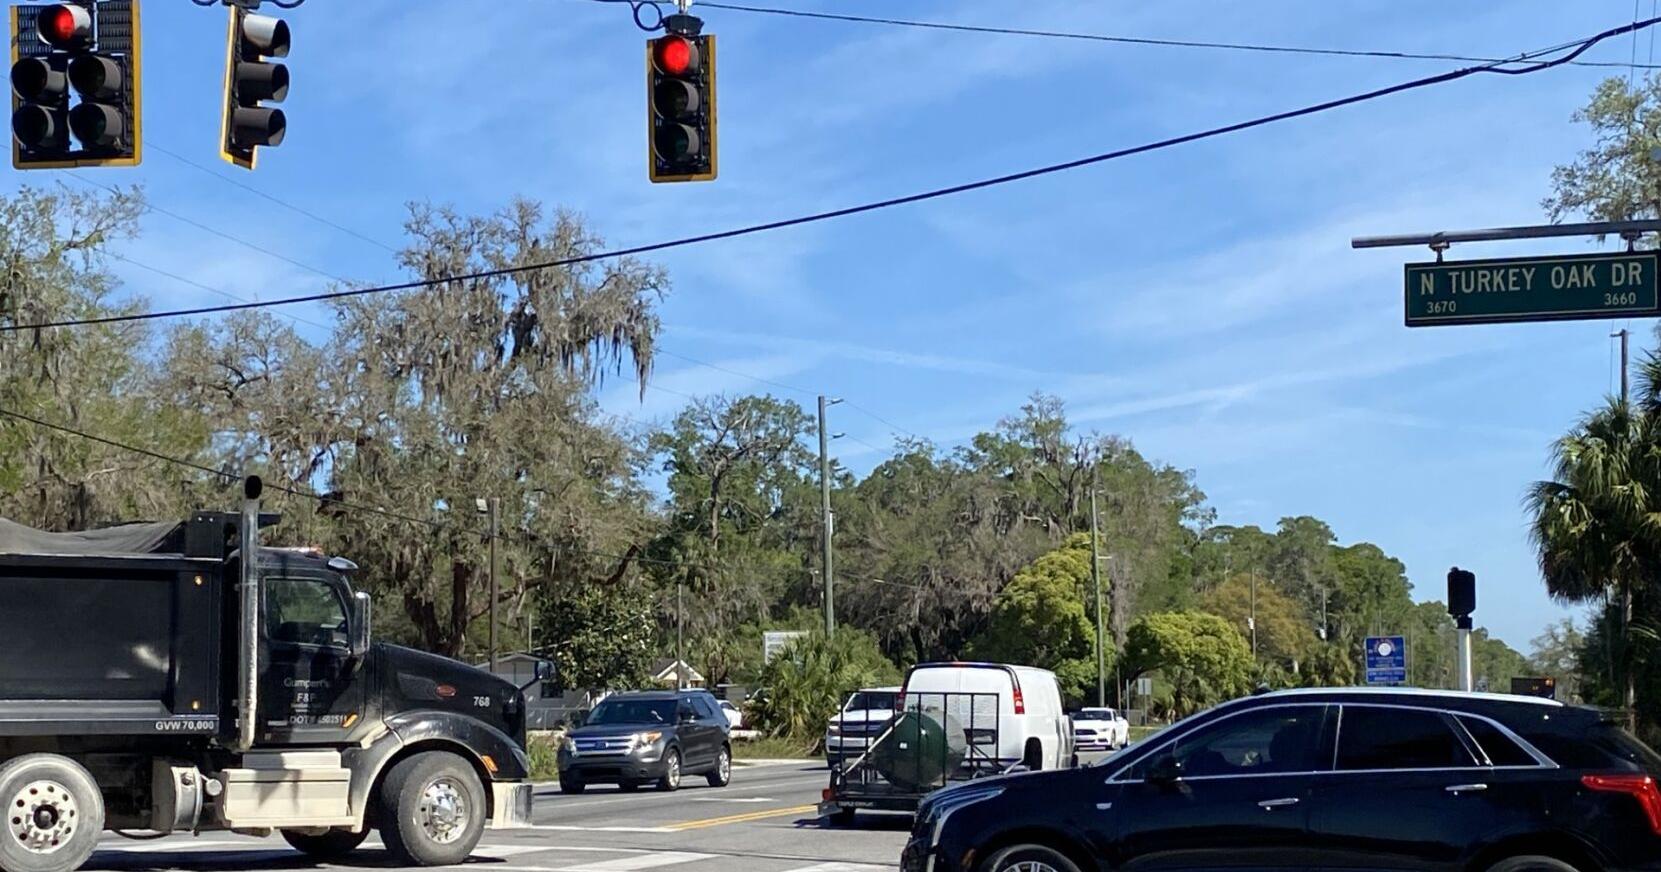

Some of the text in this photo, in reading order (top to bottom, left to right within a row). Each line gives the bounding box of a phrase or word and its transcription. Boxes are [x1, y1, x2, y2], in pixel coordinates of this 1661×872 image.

[1421, 261, 1643, 295] N TURKEY OAK DR
[1604, 291, 1637, 306] 3660
[1427, 300, 1457, 314] 3670
[473, 696, 490, 708] 768
[155, 720, 215, 731] GVW 70,000
